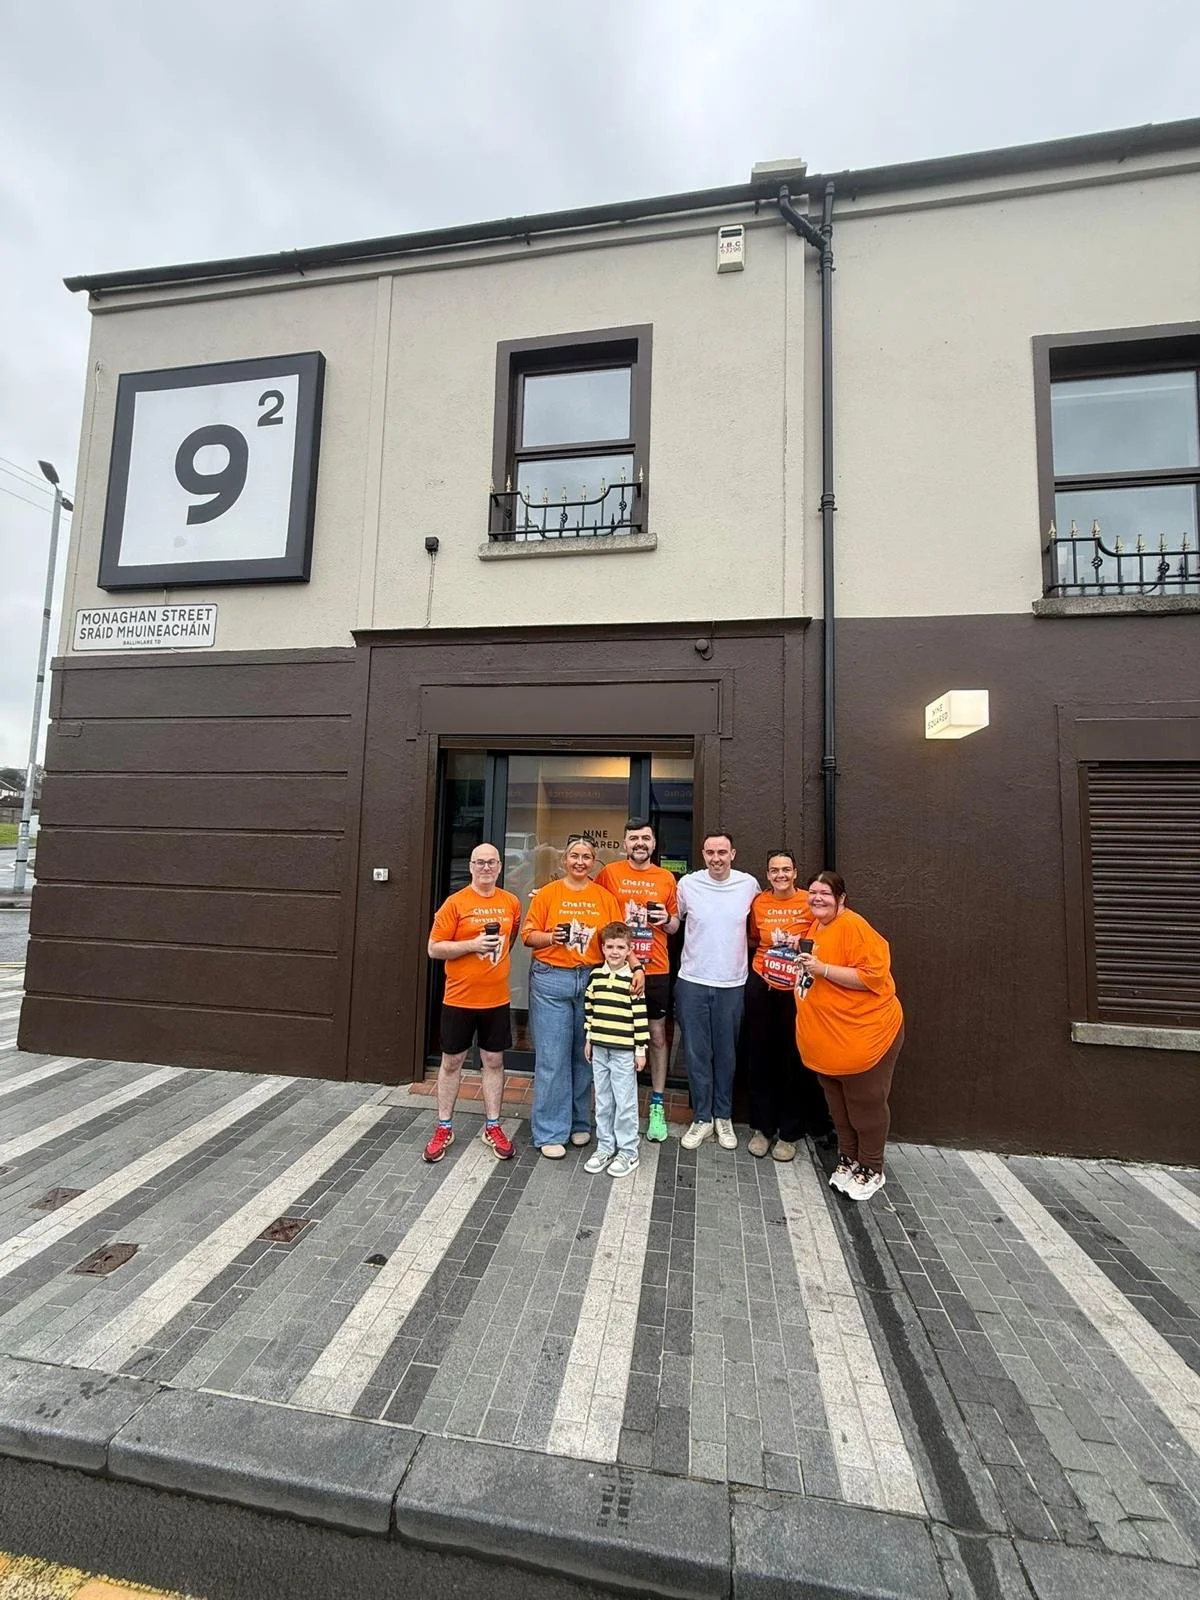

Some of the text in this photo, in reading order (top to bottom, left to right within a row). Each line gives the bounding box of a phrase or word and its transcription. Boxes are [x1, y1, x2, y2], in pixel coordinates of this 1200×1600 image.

[81, 608, 213, 625] MONAGHAN STREET
[79, 621, 211, 640] SRÁID MHUINEACHÁIN
[583, 829, 609, 838] NINE
[593, 841, 620, 849] ARED
[622, 879, 656, 887] Chester
[562, 901, 597, 909] Chester
